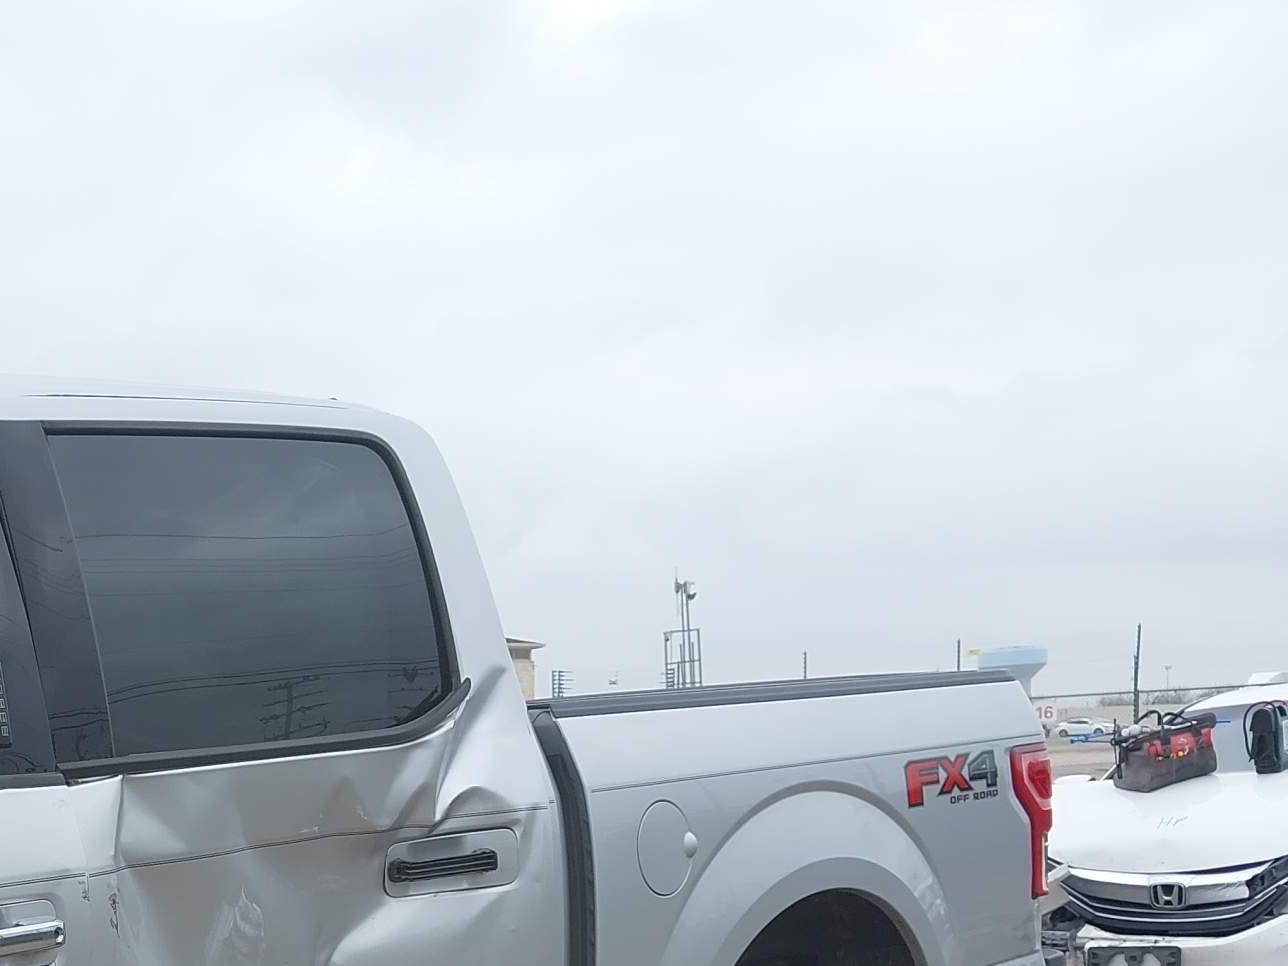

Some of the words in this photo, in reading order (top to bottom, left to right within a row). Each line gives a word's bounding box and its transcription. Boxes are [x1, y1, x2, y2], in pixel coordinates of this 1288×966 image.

[1035, 705, 1053, 720] 16
[904, 749, 998, 808] FX4
[950, 794, 969, 804] OFF
[973, 789, 999, 801] ROAD
